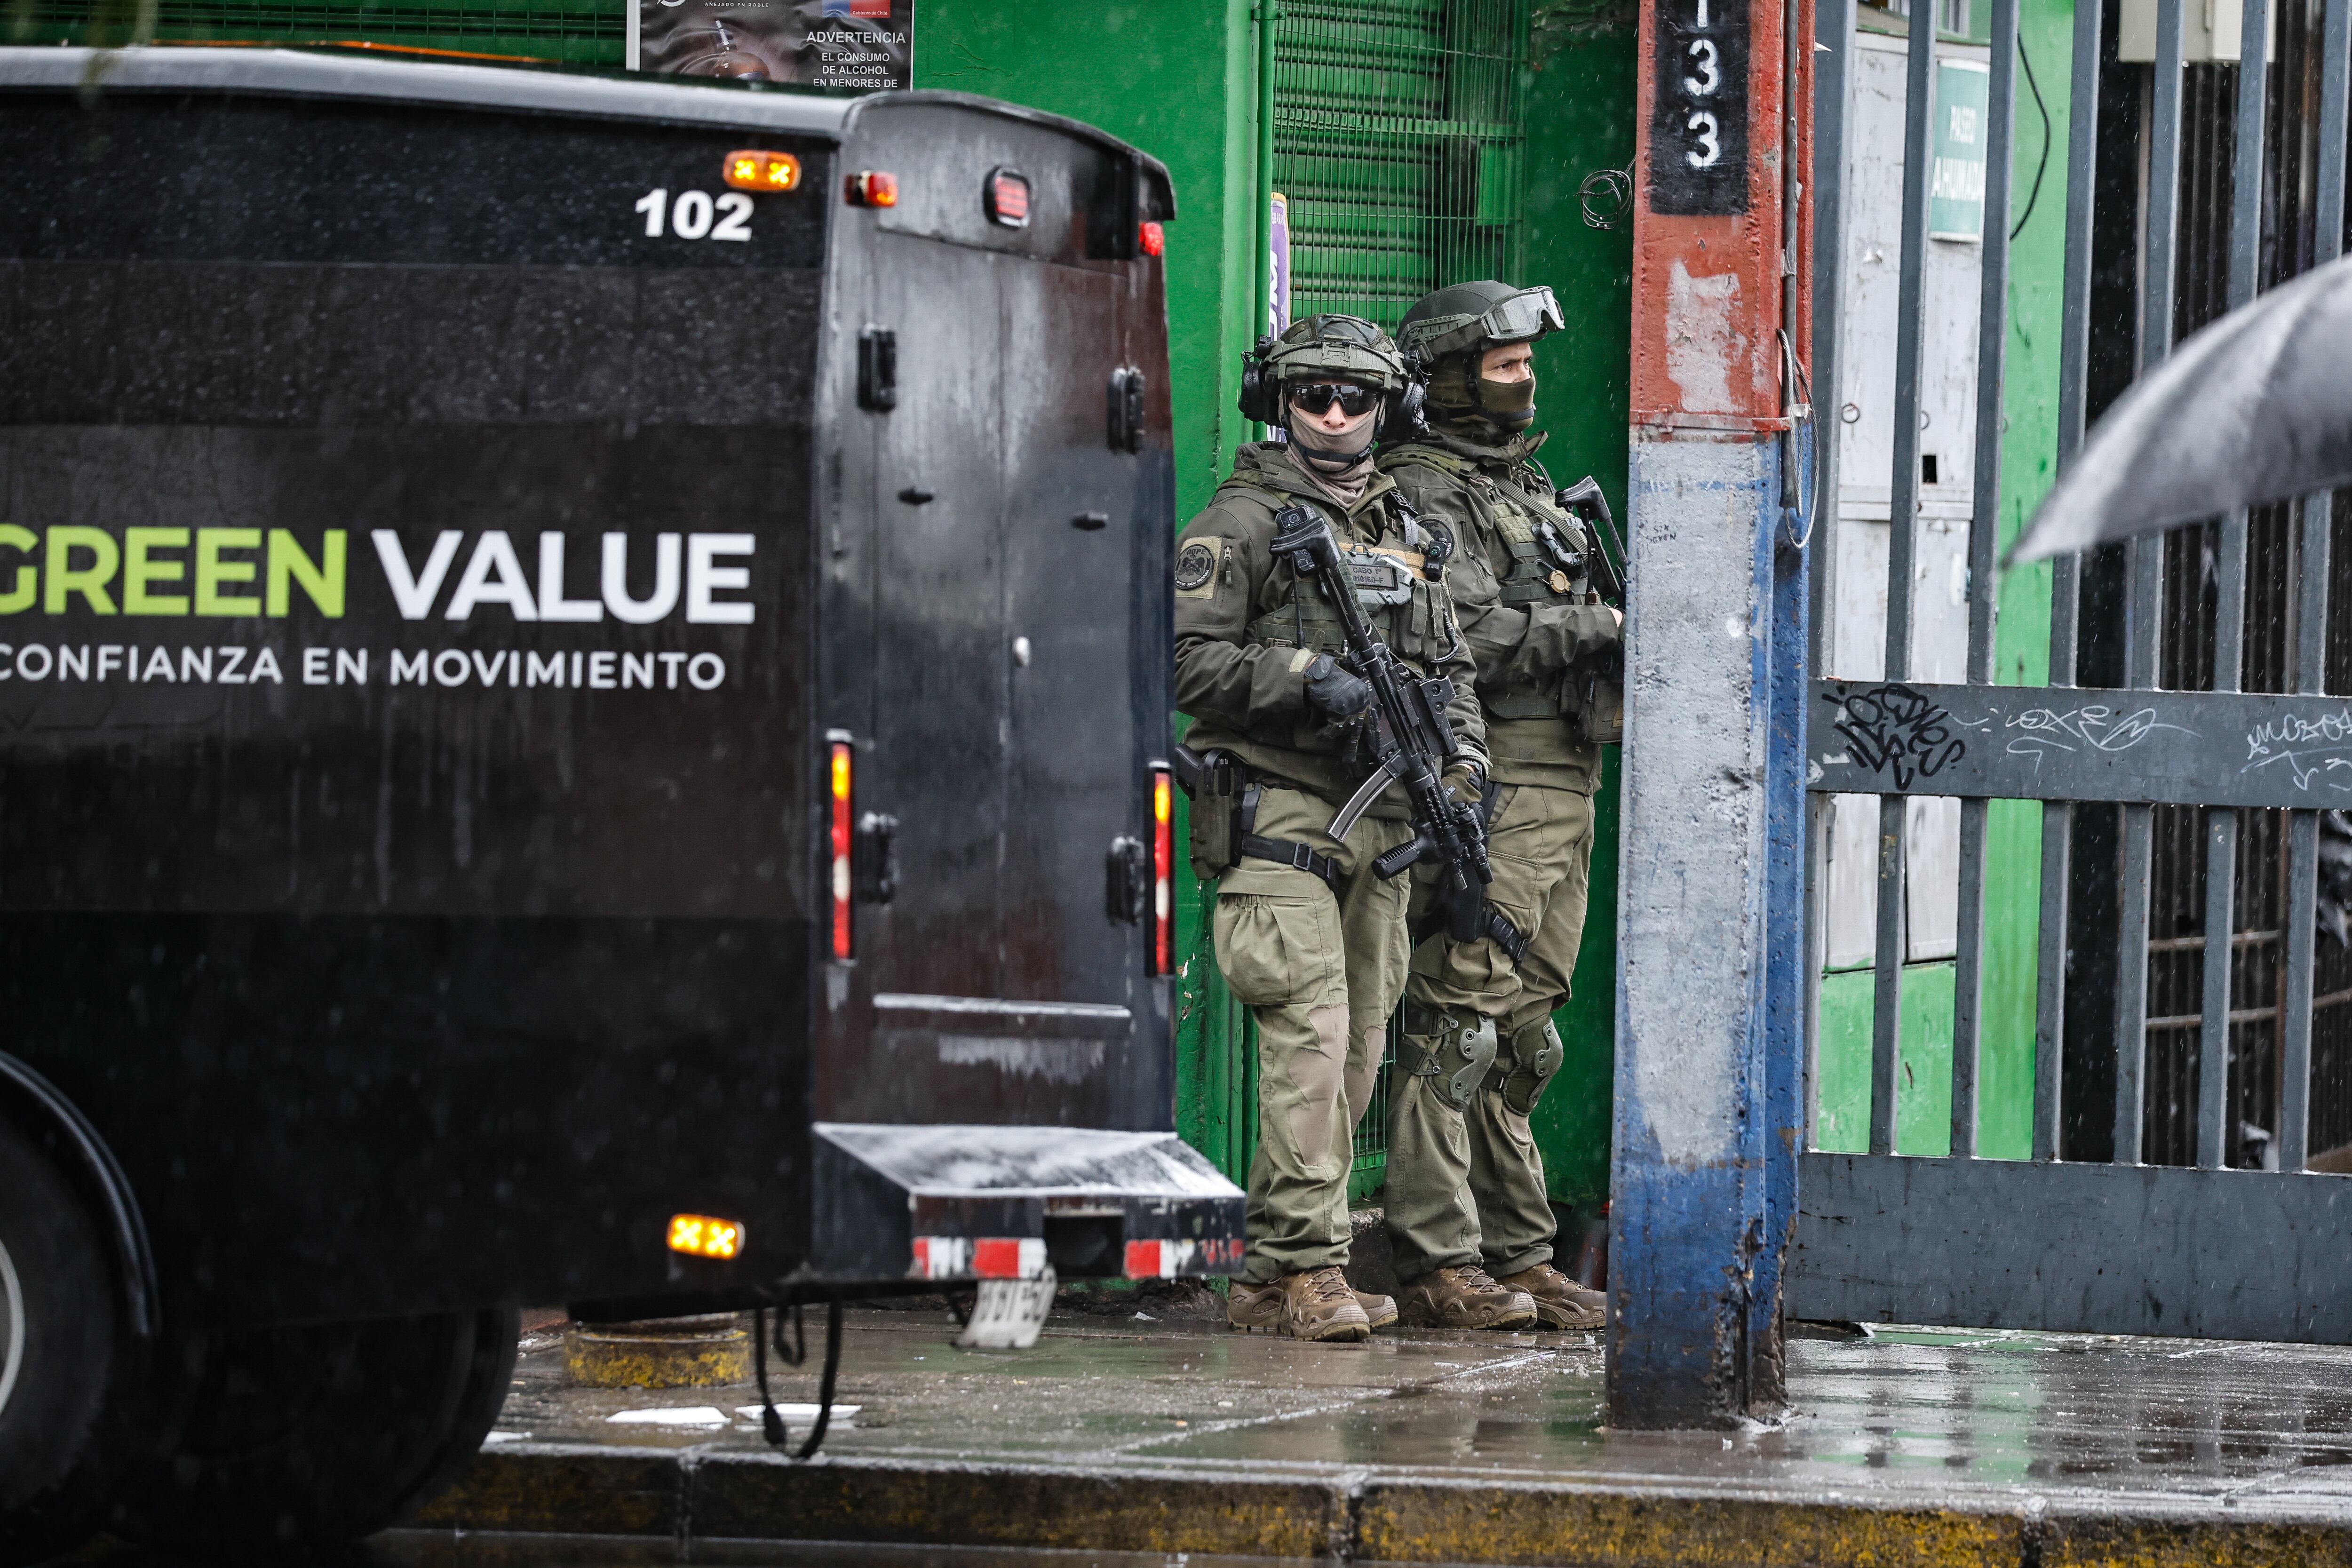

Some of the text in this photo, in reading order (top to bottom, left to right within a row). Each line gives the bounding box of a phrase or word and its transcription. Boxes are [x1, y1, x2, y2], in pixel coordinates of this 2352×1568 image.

[806, 31, 906, 43] ADVERTENCIA
[822, 52, 890, 62] EL CONSUMO
[822, 65, 889, 75] DE ALCOHOL
[813, 78, 898, 88] EN MENORES DE
[635, 188, 755, 242] 102
[371, 529, 755, 624] VALUE
[303, 647, 368, 685] EN
[390, 648, 726, 690] MOVIMIENTO
